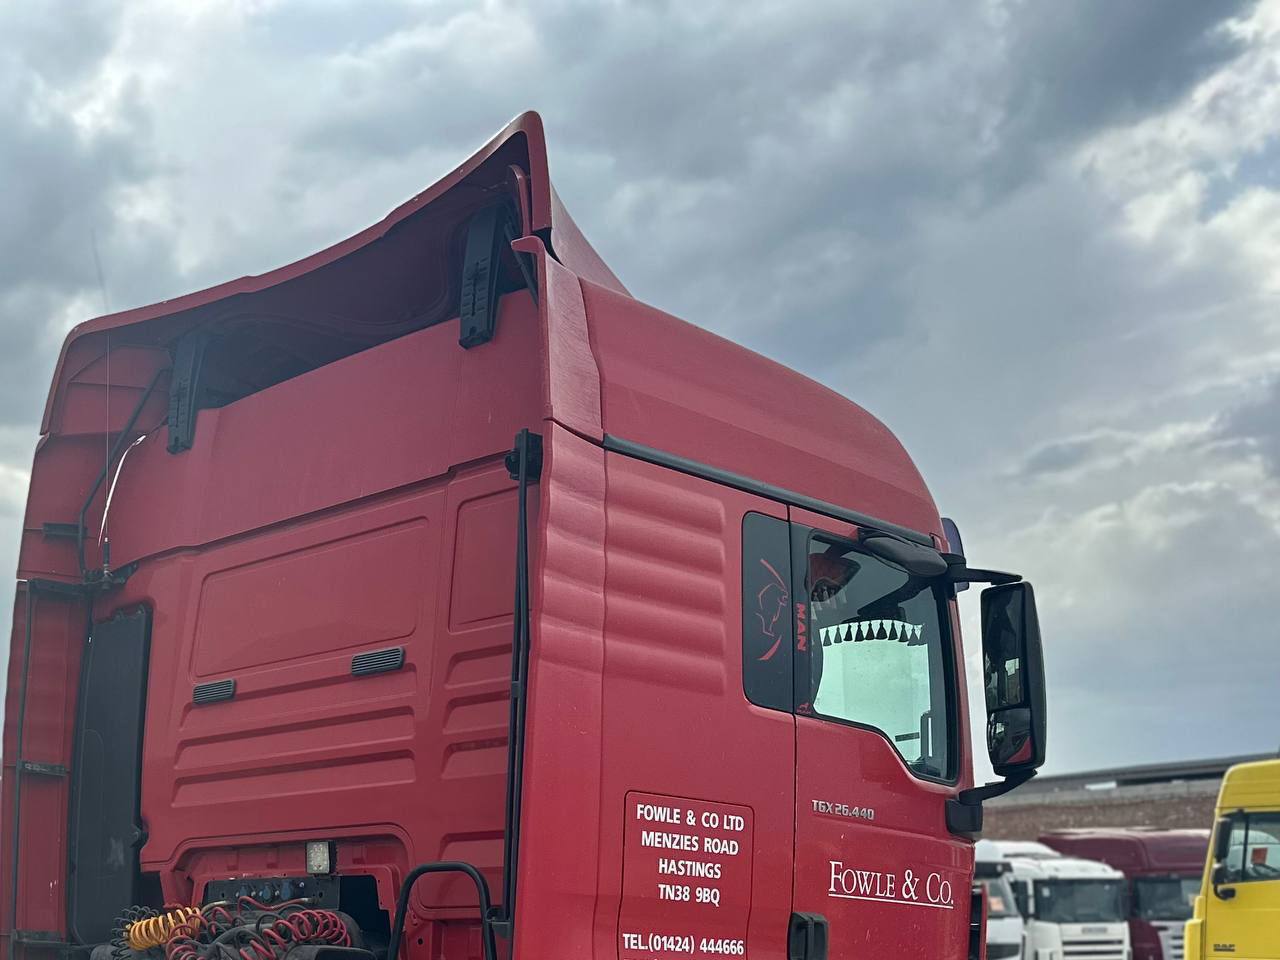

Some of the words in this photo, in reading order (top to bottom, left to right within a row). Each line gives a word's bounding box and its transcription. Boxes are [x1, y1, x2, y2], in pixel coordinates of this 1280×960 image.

[797, 603, 807, 651] MAN
[636, 804, 681, 824] FOWLE
[686, 809, 697, 826] &
[701, 812, 719, 828] CO
[723, 814, 745, 831] LTD
[812, 799, 833, 814] TGX
[835, 803, 875, 820] 26.440
[641, 831, 699, 852] MENZIES
[703, 837, 739, 855] ROAD
[658, 858, 722, 879] HASTINGS
[658, 884, 691, 902] TN38
[695, 887, 721, 907] 9BQ
[902, 869, 920, 900] &
[699, 938, 745, 955] 444666
